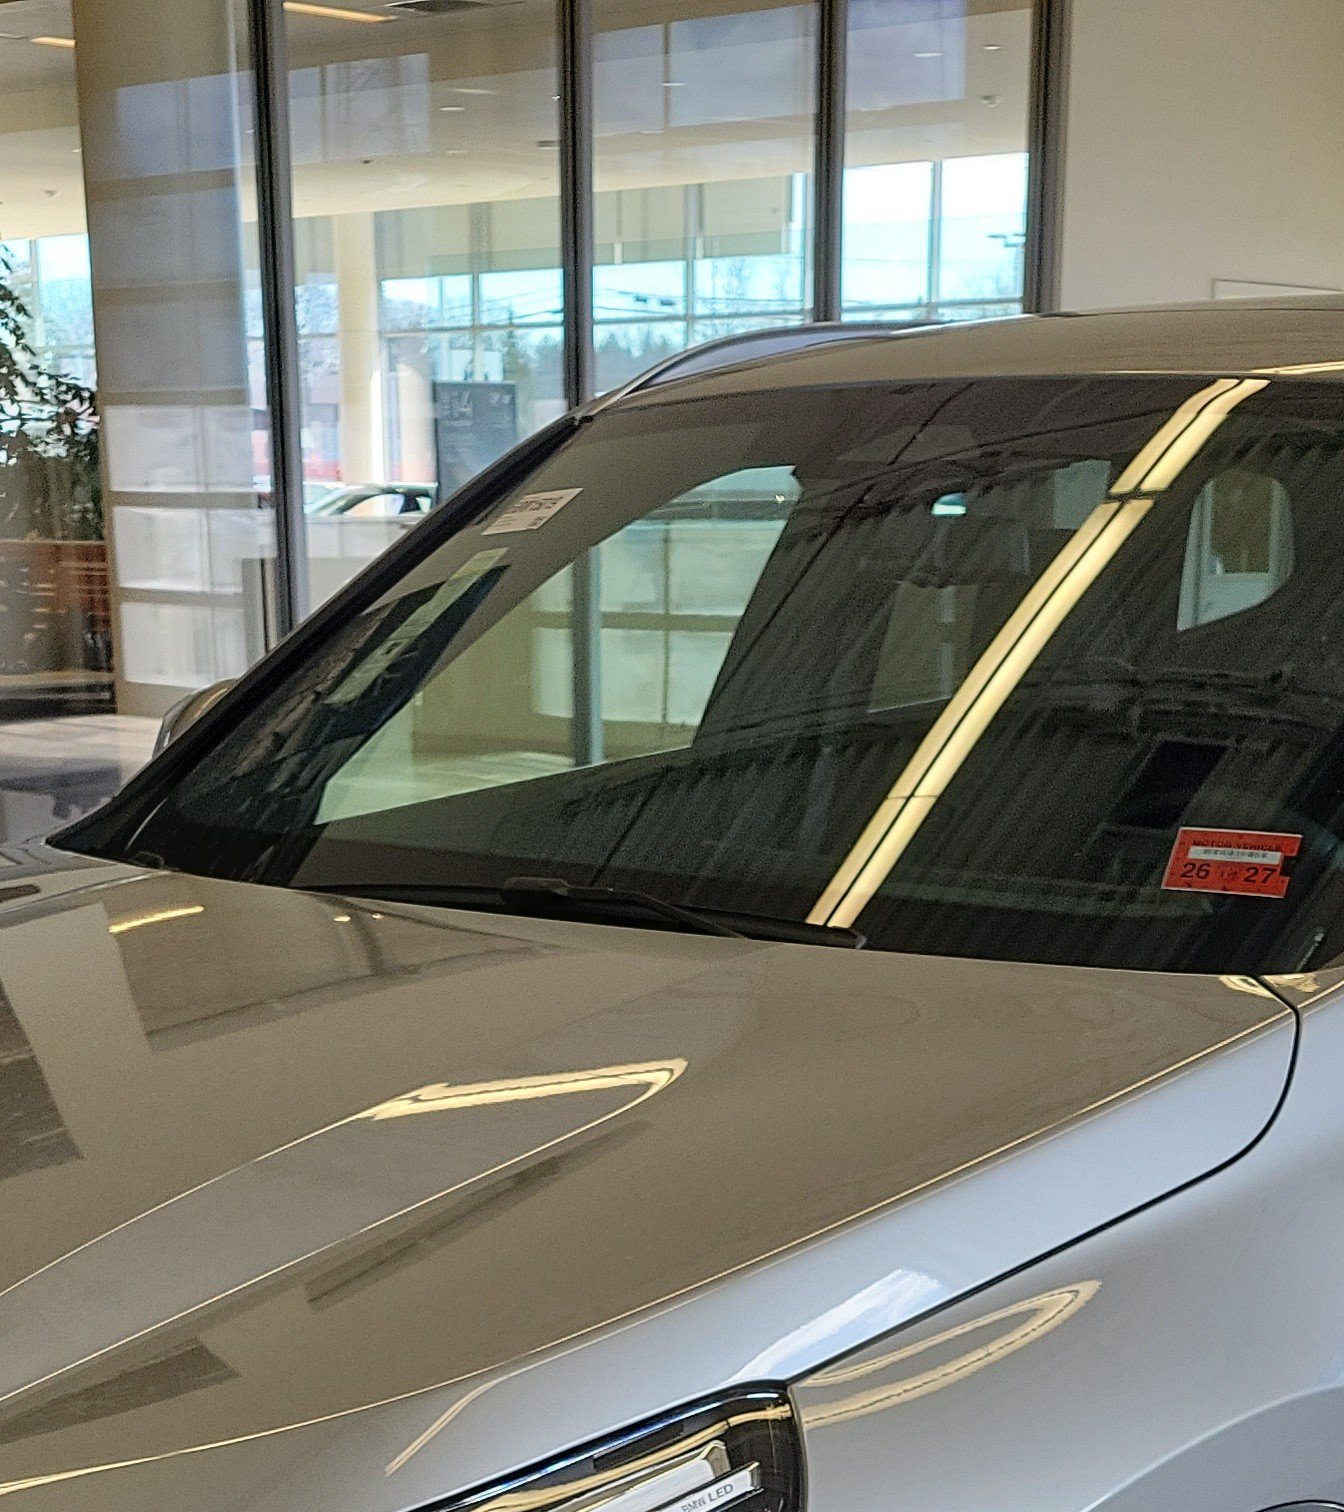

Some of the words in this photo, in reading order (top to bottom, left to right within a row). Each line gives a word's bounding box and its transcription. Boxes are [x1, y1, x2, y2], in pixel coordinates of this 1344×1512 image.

[1180, 862, 1211, 880] 26
[1243, 866, 1277, 885] 27
[707, 1483, 734, 1502] LED
